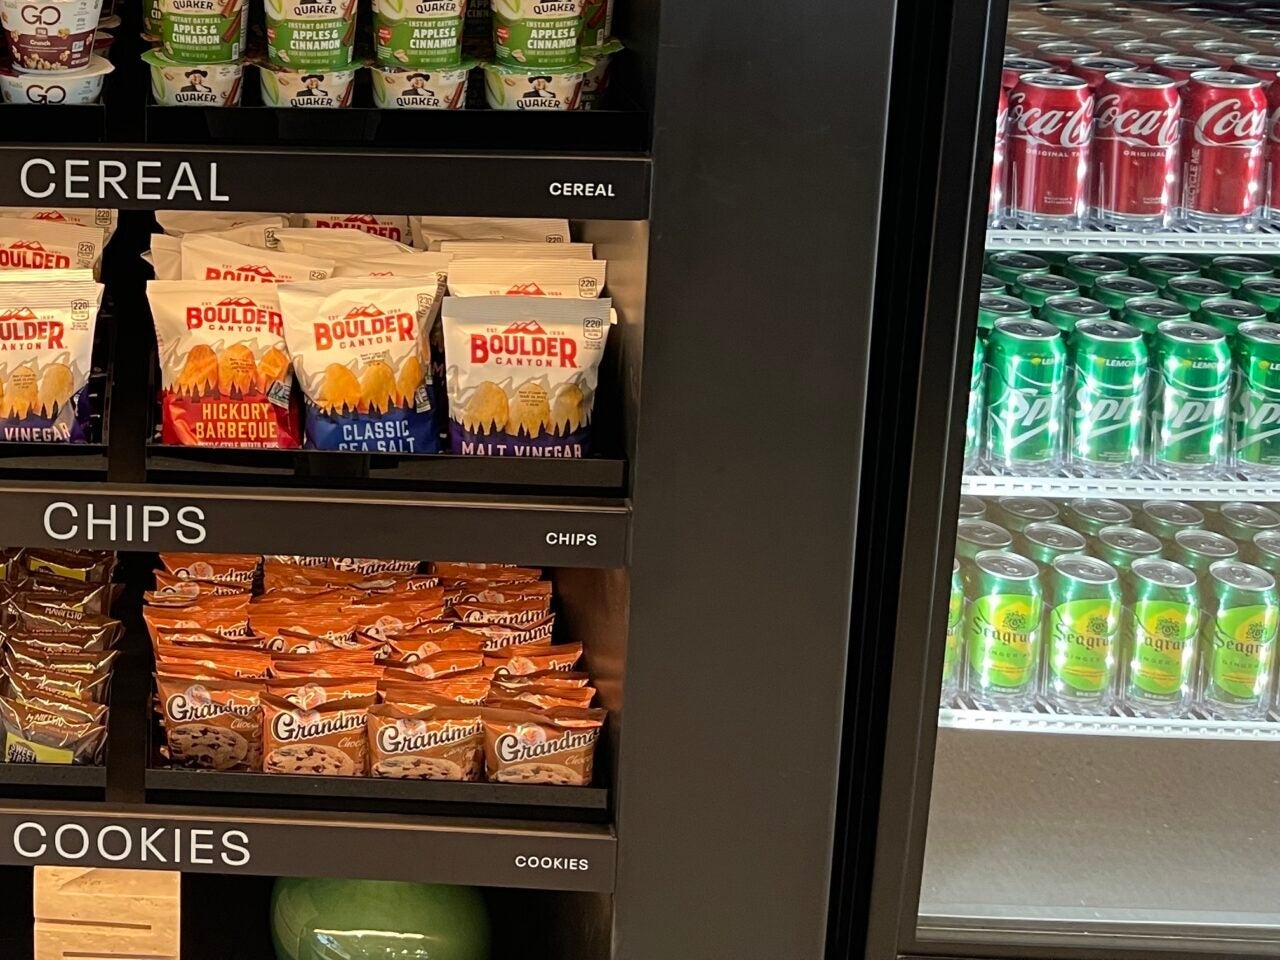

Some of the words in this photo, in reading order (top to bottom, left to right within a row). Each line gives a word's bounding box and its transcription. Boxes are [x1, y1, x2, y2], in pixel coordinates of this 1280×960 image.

[21, 4, 62, 26] GO
[19, 157, 231, 203] CEREAL
[549, 182, 615, 198] CEREAL
[186, 306, 283, 338] BOULDER
[313, 311, 414, 351] BOULDER
[339, 334, 393, 350] CANYON
[470, 333, 578, 369] BOULDER
[495, 357, 553, 367] CANYON
[202, 403, 269, 420] HICKORY
[195, 421, 277, 439] BARBEQUE
[342, 419, 410, 441] CLASSIC
[42, 501, 209, 545] CHIPS
[545, 532, 597, 546] CHIPS
[12, 821, 252, 867] COOKIES
[515, 855, 589, 871] COOKIES
